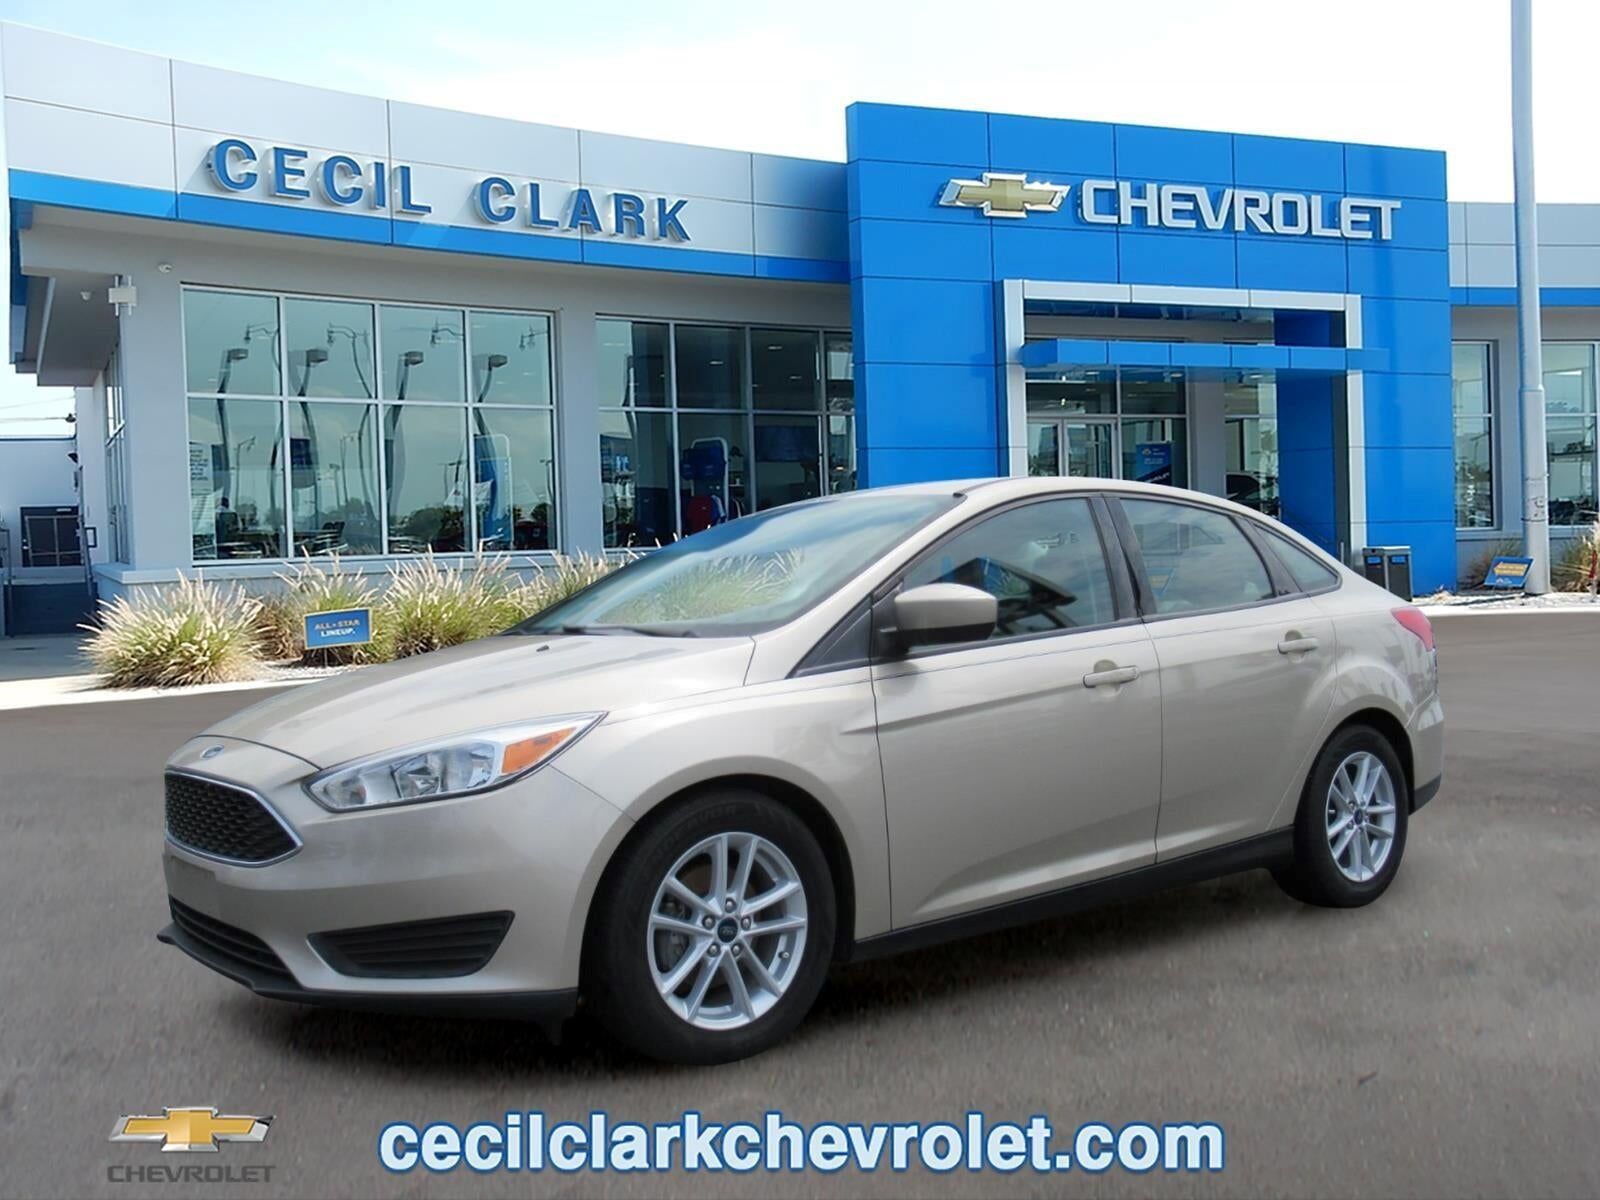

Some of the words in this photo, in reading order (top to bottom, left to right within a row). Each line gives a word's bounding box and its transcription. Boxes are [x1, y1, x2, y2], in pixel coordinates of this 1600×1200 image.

[212, 139, 432, 213] CECIL
[477, 177, 691, 241] CLARK
[1080, 179, 1402, 240] CHEVROLET
